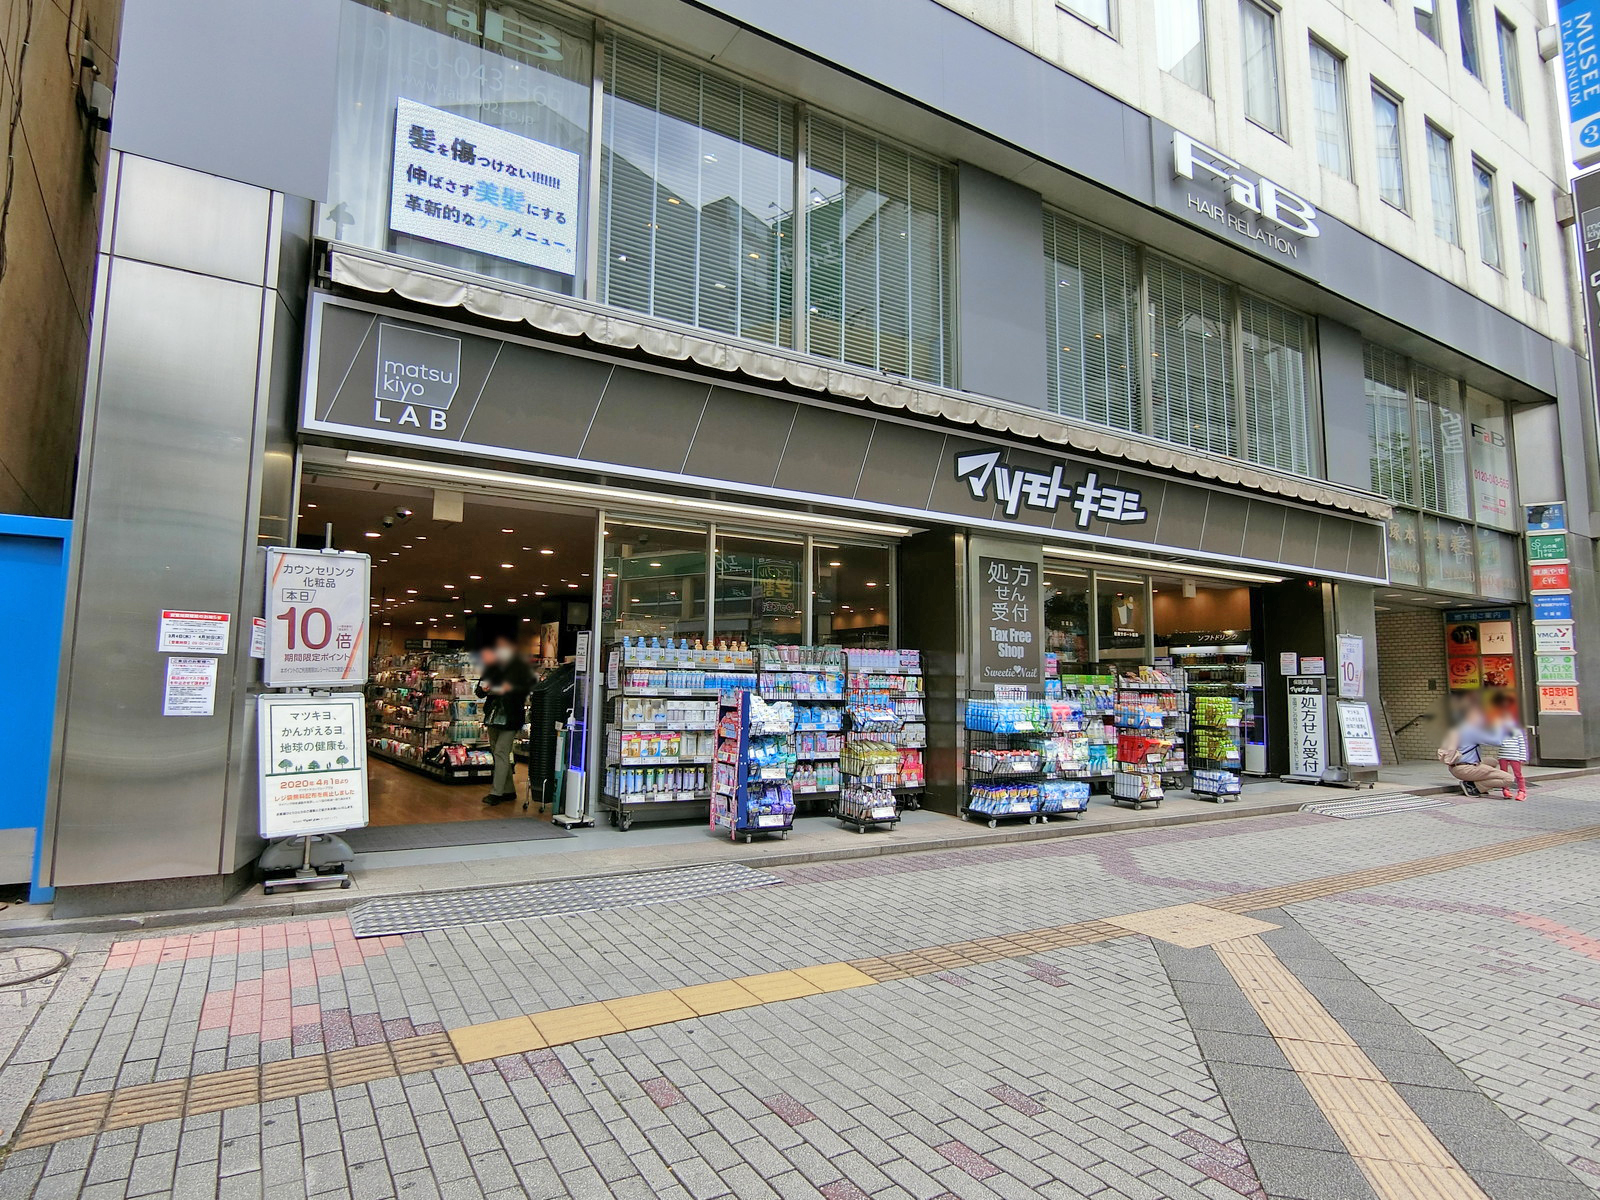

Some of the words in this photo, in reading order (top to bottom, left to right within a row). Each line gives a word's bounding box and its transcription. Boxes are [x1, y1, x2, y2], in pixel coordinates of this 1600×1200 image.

[1562, 20, 1582, 107] PLATINUM
[1574, 11, 1600, 101] MUSEE
[1583, 125, 1600, 145] 3
[406, 164, 567, 225] 伸ばさず美髪にする
[1173, 130, 1320, 238] FaB
[404, 193, 572, 254] 革新的なケアメニュー。
[1187, 193, 1224, 224] HAIR
[1228, 213, 1298, 259] RELATION
[384, 360, 453, 384] matsu
[384, 374, 425, 402] kiyo
[374, 400, 448, 431] LAB
[1471, 423, 1506, 448] FaB
[957, 451, 1146, 526] マツモトキヨシ
[283, 564, 355, 577] カウンセリング
[987, 561, 1032, 587] 処方
[303, 577, 336, 588] 化粧品
[286, 591, 310, 601] 本日
[994, 586, 1026, 602] せん
[991, 602, 1029, 623] 受付
[277, 607, 333, 650] 10
[335, 632, 352, 649] 倍
[989, 627, 1009, 642] Tax
[1010, 628, 1032, 643] Free
[1198, 634, 1239, 642] ソフトドリンク
[284, 653, 351, 662] 期間限定ポイント
[997, 642, 1025, 659] Shop
[984, 665, 1015, 678] Sweetie
[1018, 668, 1038, 678] Nail
[1341, 661, 1355, 682] 10
[290, 710, 337, 721] マツキヨ、
[281, 725, 346, 738] かんがえるヨ。
[1300, 696, 1320, 773] 処方せん受付
[280, 740, 349, 754] 地球の健康も。
